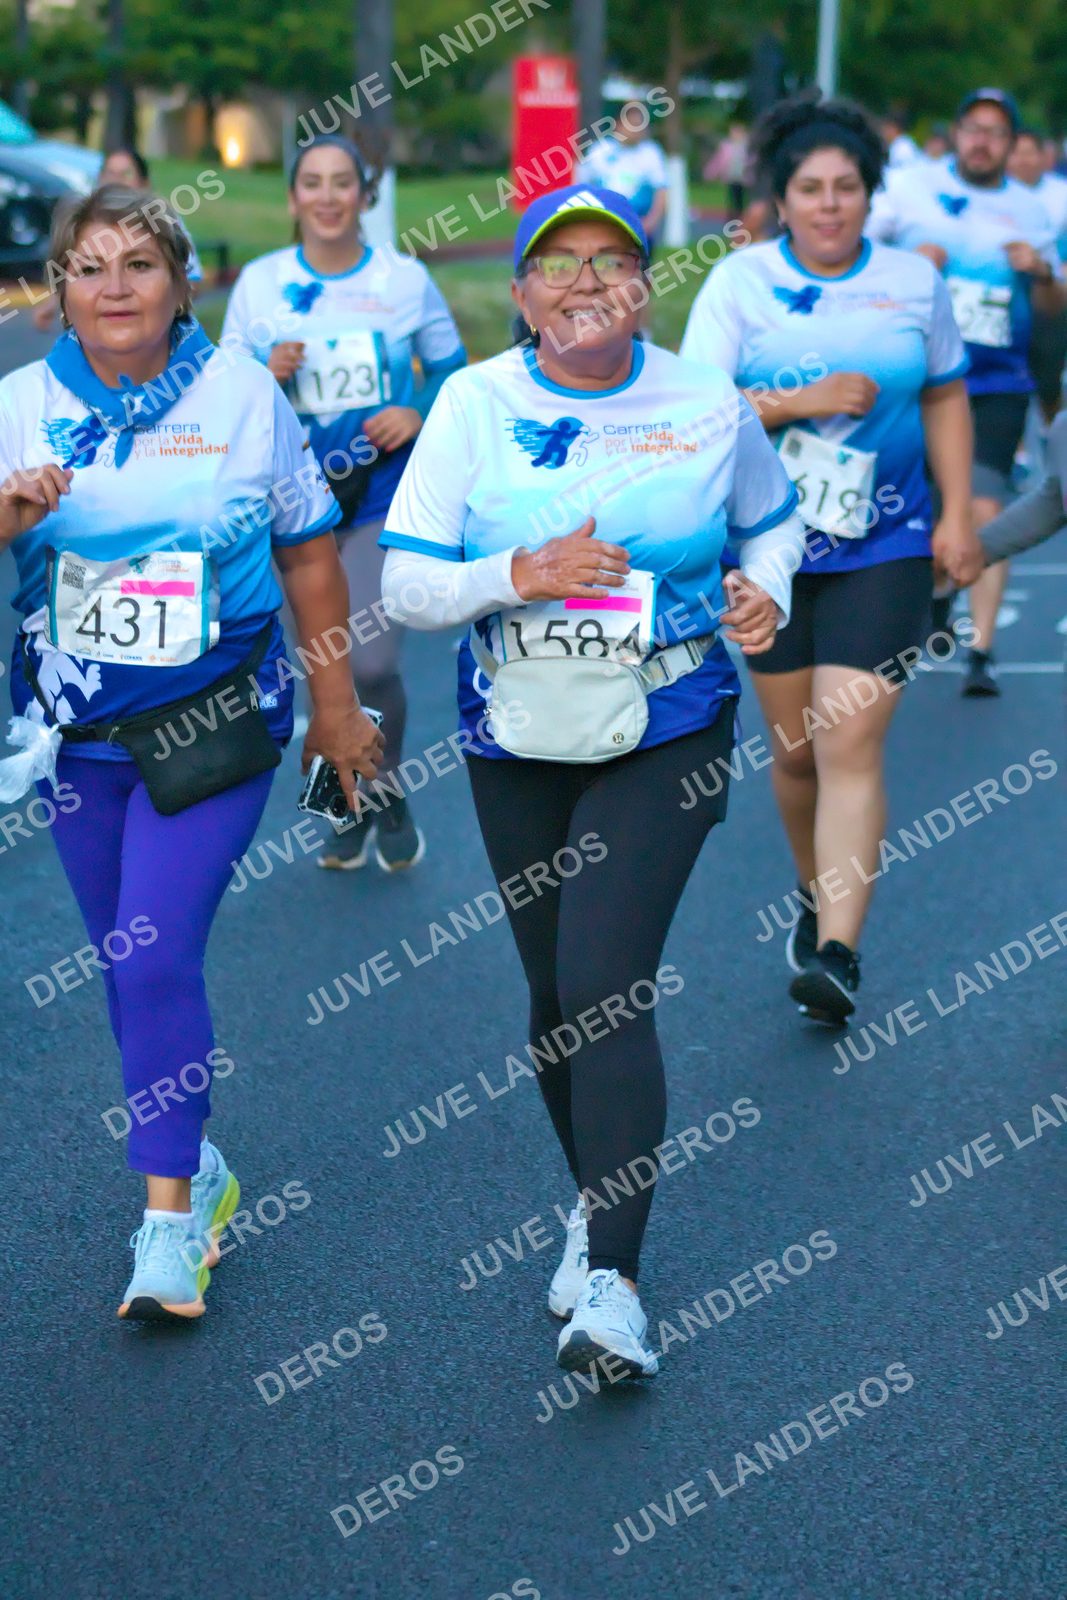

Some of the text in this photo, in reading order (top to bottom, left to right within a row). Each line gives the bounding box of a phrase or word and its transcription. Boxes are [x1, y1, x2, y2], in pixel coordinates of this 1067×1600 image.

[311, 362, 375, 401] 123
[604, 420, 672, 435] Carrera
[173, 434, 204, 446] Vida
[159, 443, 229, 458] Integridad
[75, 595, 167, 649] 431
